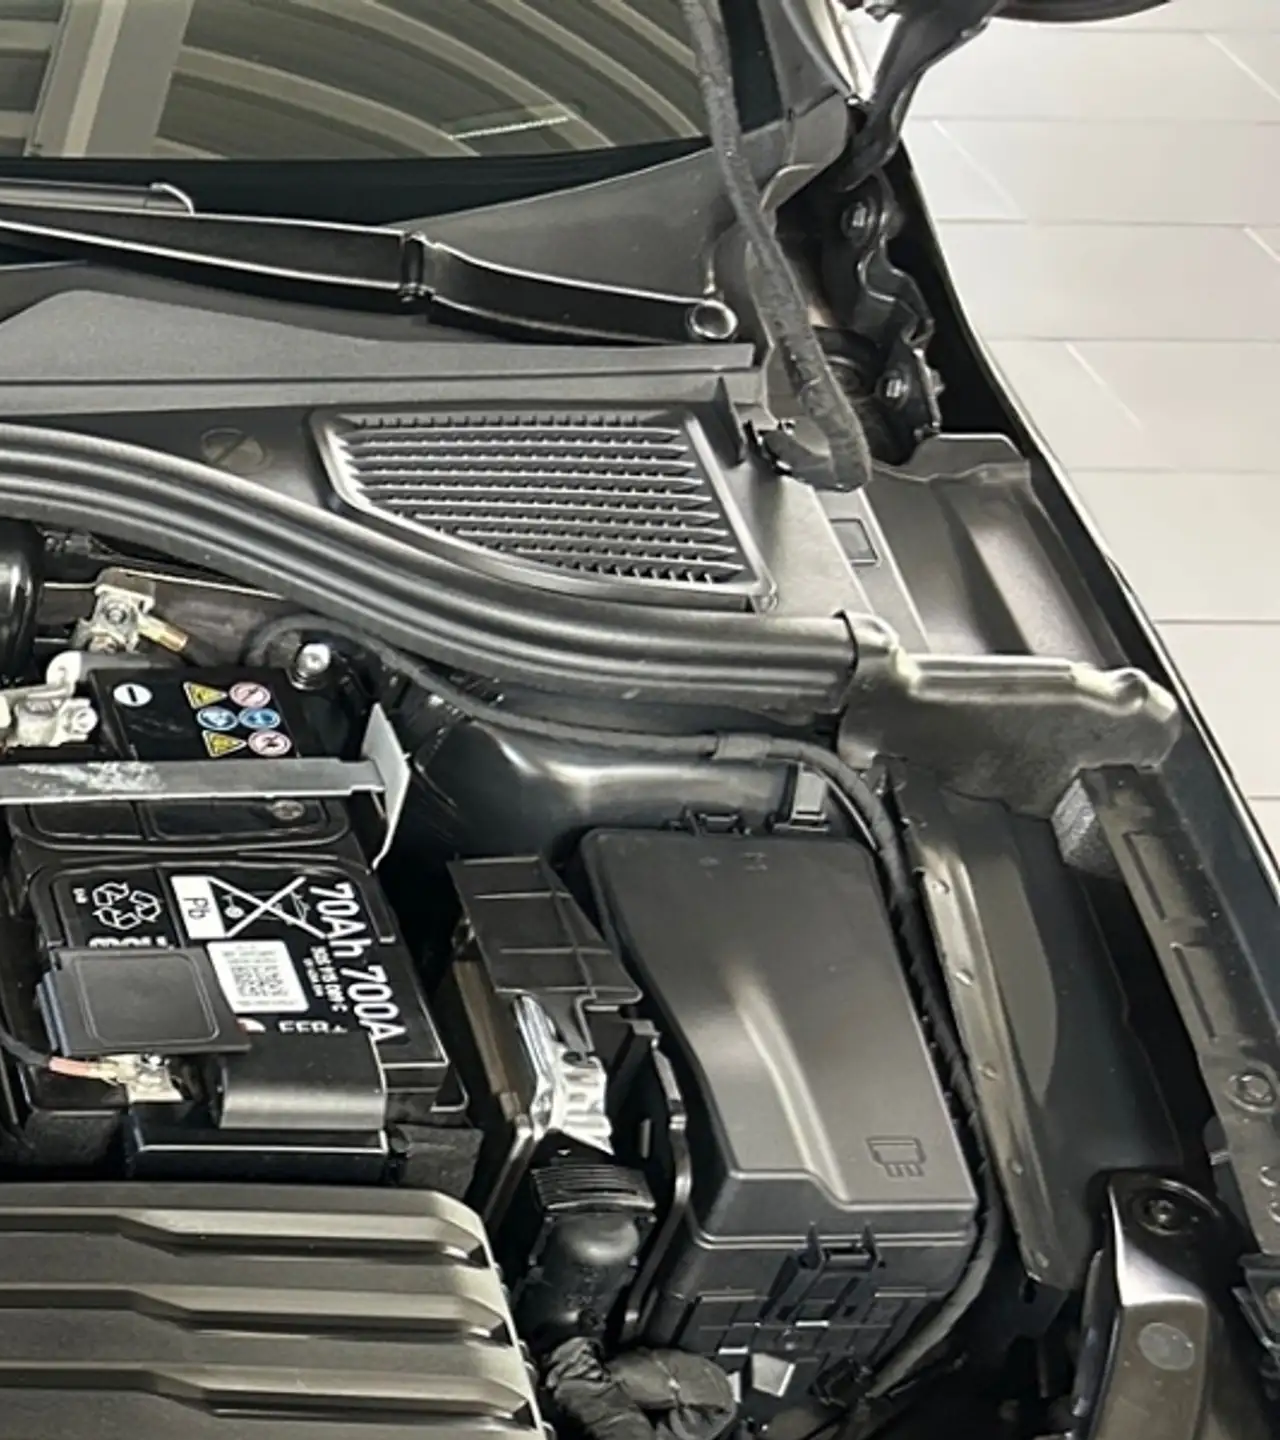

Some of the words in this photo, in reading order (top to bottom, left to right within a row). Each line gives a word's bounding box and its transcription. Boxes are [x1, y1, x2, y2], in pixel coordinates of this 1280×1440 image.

[183, 897, 210, 919] Pb
[308, 882, 371, 958] 70Ah
[339, 964, 407, 1042] 700A
